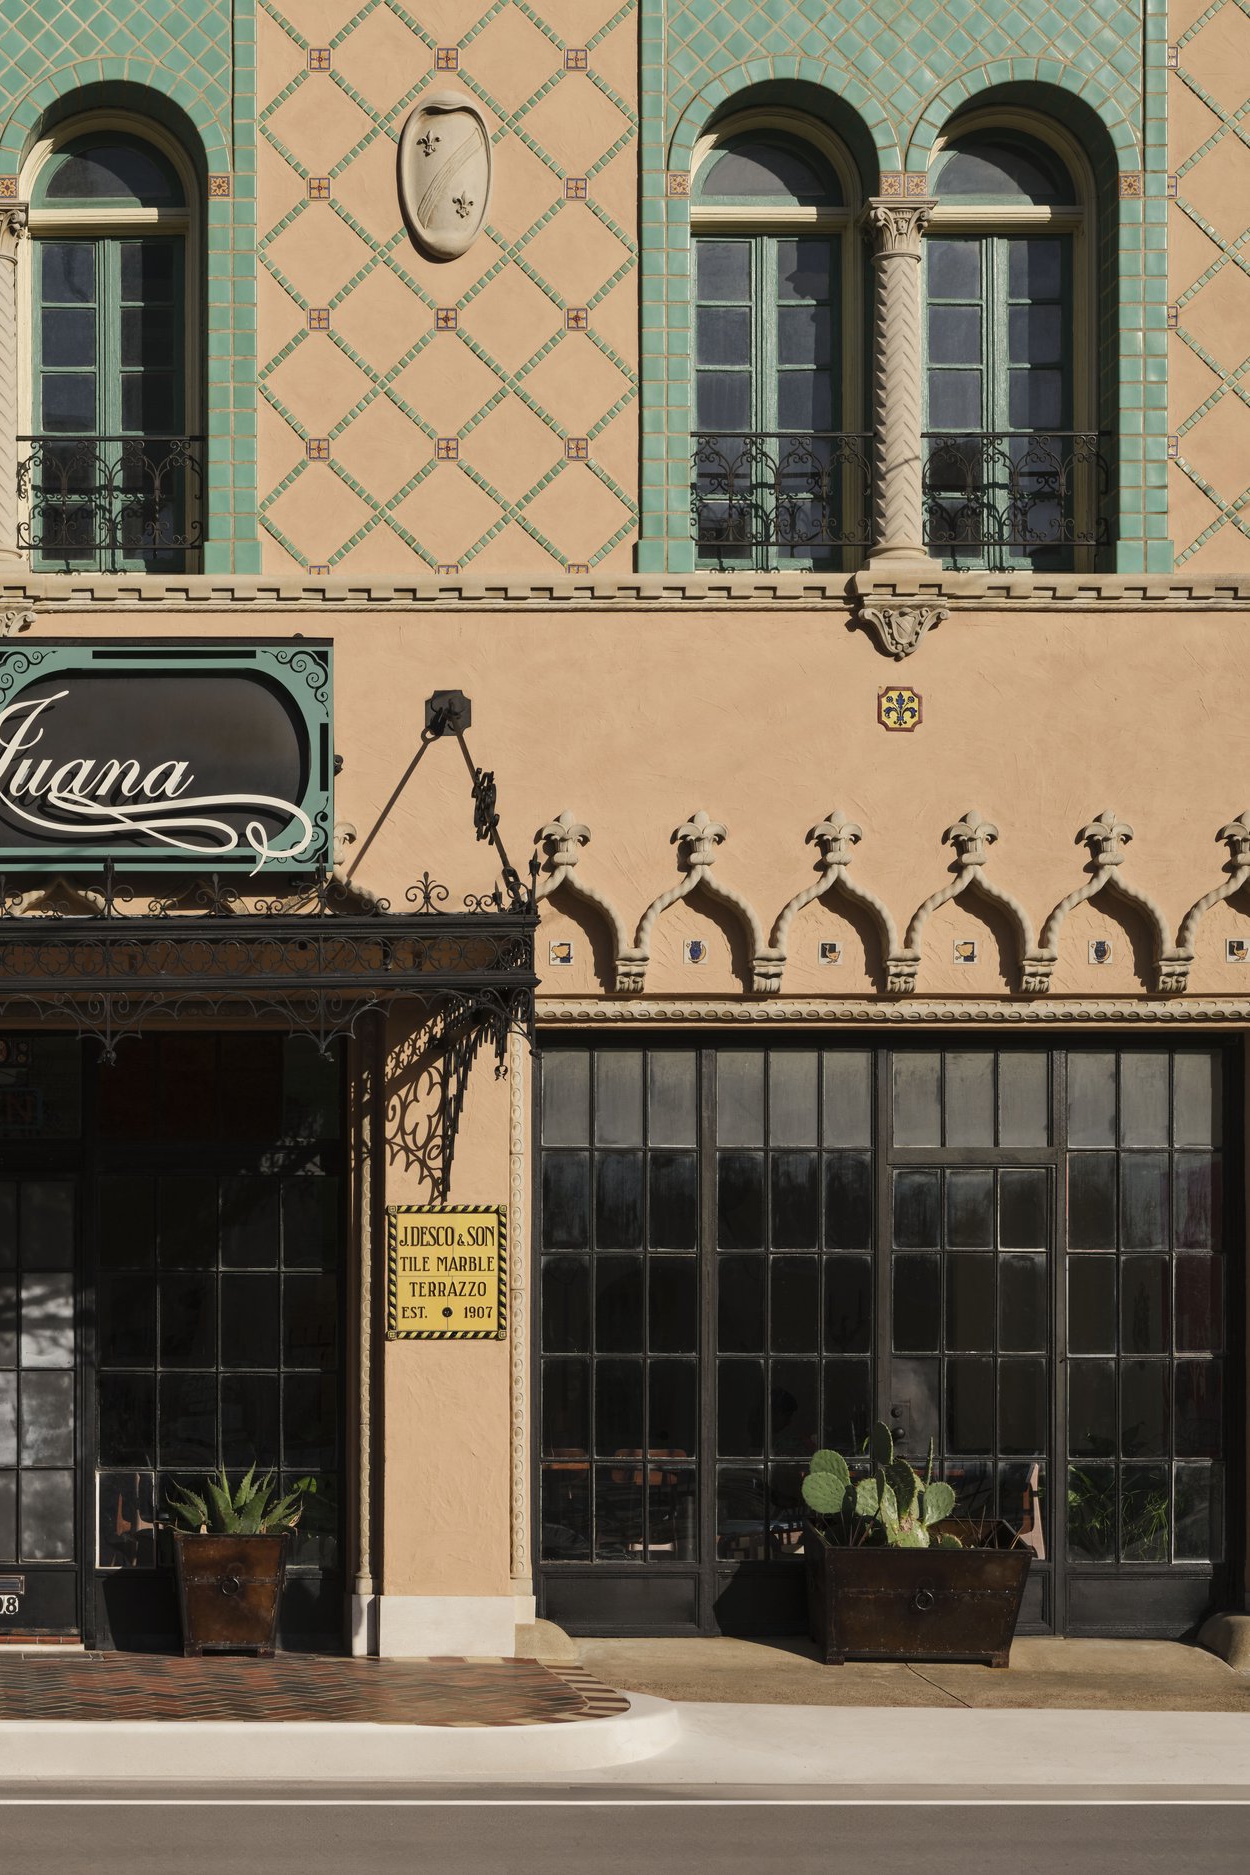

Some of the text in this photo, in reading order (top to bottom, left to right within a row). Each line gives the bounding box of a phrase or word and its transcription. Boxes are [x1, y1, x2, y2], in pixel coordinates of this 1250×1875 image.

[456, 1233, 466, 1247] &
[467, 1226, 495, 1247] SON
[400, 1256, 495, 1272] TILE MARBLE
[409, 1281, 487, 1297] TERRAZZO
[401, 1306, 493, 1319] EST. 1907
